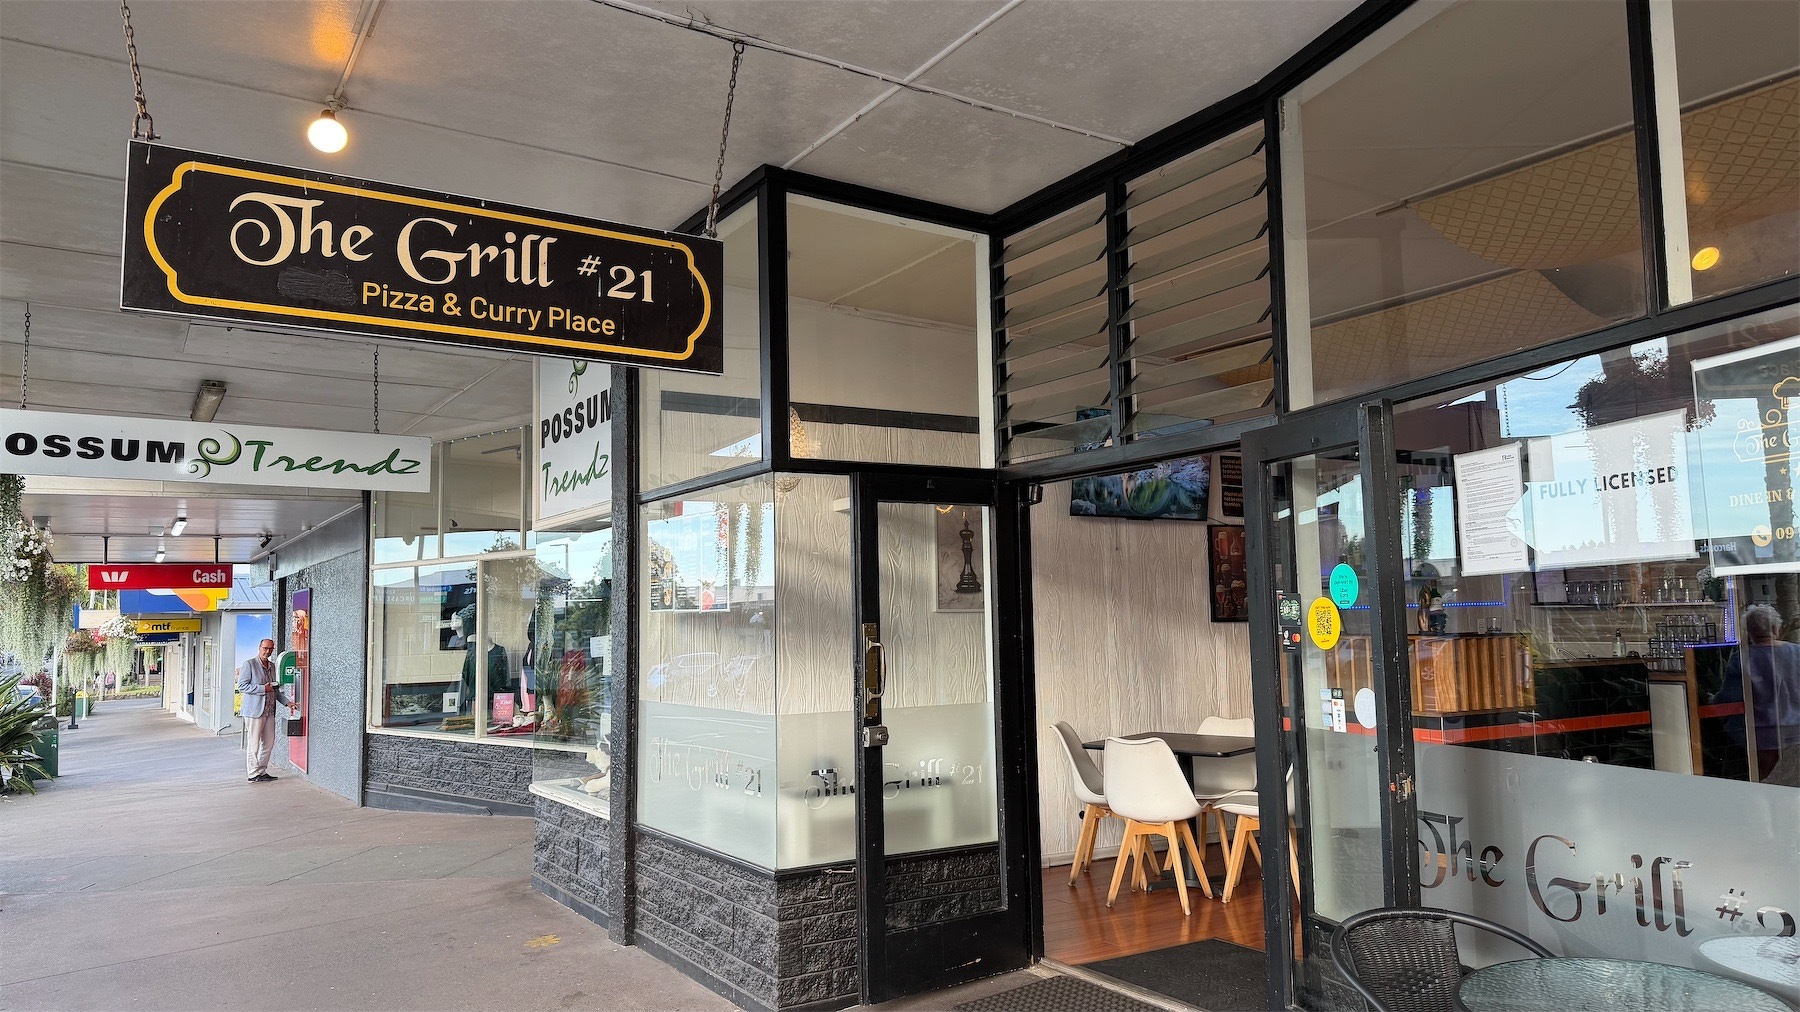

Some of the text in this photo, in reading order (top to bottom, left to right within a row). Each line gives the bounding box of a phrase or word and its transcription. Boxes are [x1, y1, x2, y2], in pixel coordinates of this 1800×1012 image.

[229, 192, 654, 303] The Grill #21
[362, 281, 616, 336] Pizza & Curry Place
[0, 432, 420, 475] OSSUM Trendz
[1745, 432, 1777, 455] The
[542, 441, 609, 502] Trendz
[1539, 465, 1679, 500] FULLY LICENSED
[1729, 492, 1763, 507] DINE
[1766, 488, 1783, 502] IN
[1775, 526, 1795, 540] 09
[192, 569, 226, 584] Cash
[151, 622, 171, 631] mtf
[1418, 810, 1505, 889] The
[1525, 834, 1694, 938] Grill
